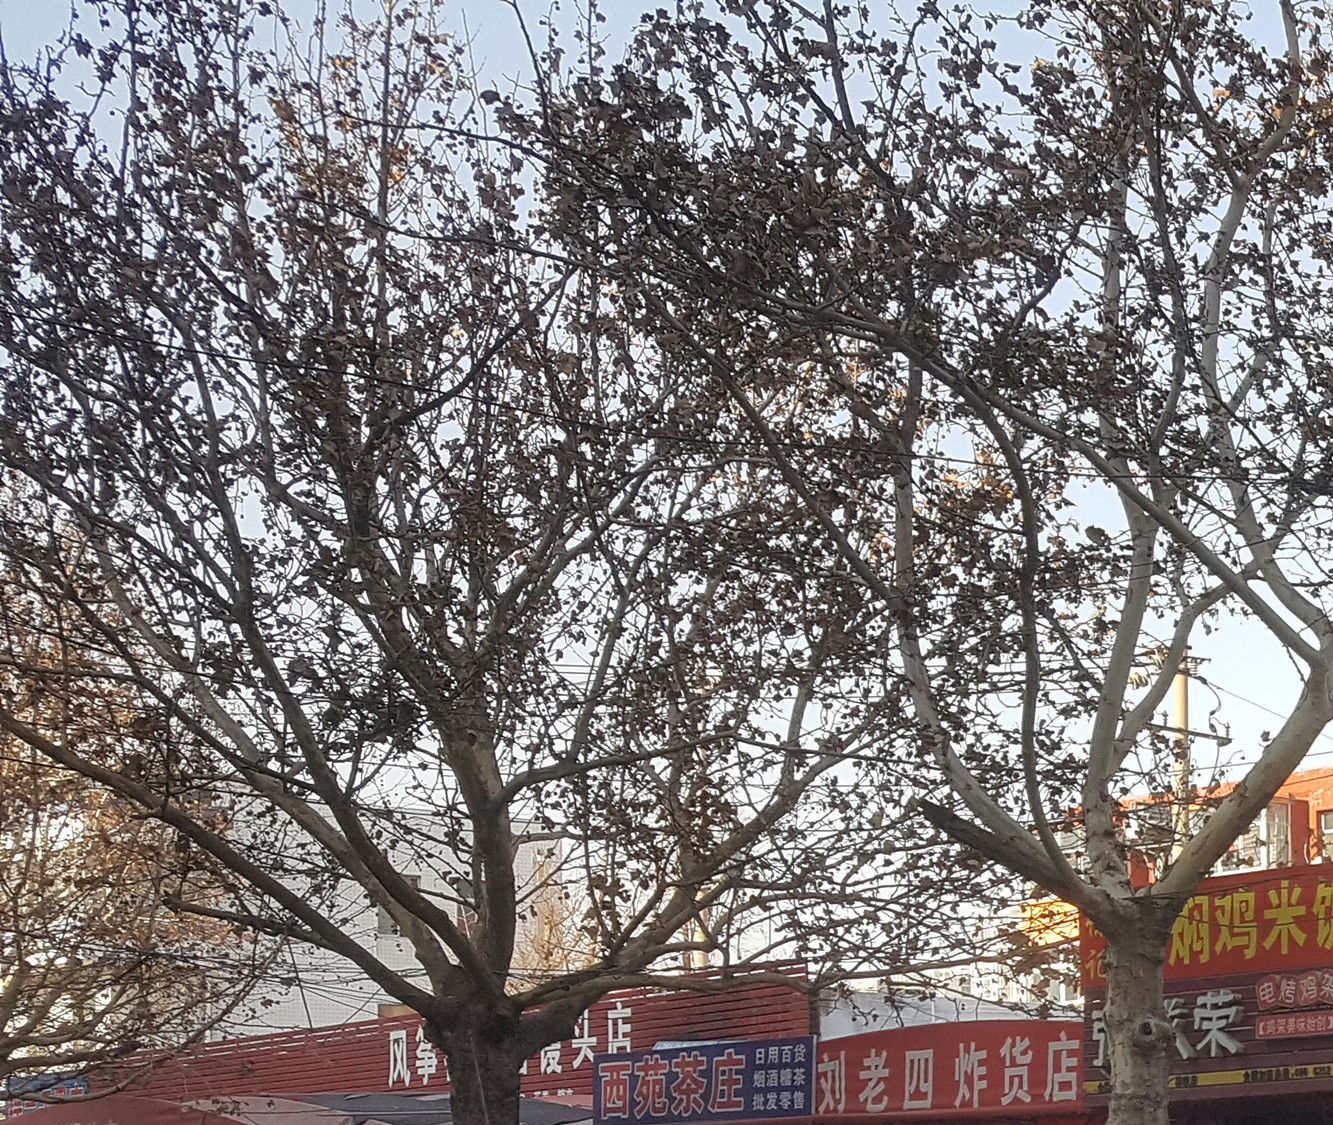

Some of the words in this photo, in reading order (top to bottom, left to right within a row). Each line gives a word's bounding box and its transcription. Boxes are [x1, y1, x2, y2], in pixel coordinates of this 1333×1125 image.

[755, 1044, 806, 1065] 日用百货
[818, 1030, 1081, 1115] 刘老四炸货店
[599, 1048, 746, 1120] 西苑茶庄
[752, 1091, 805, 1111] 批发零售
